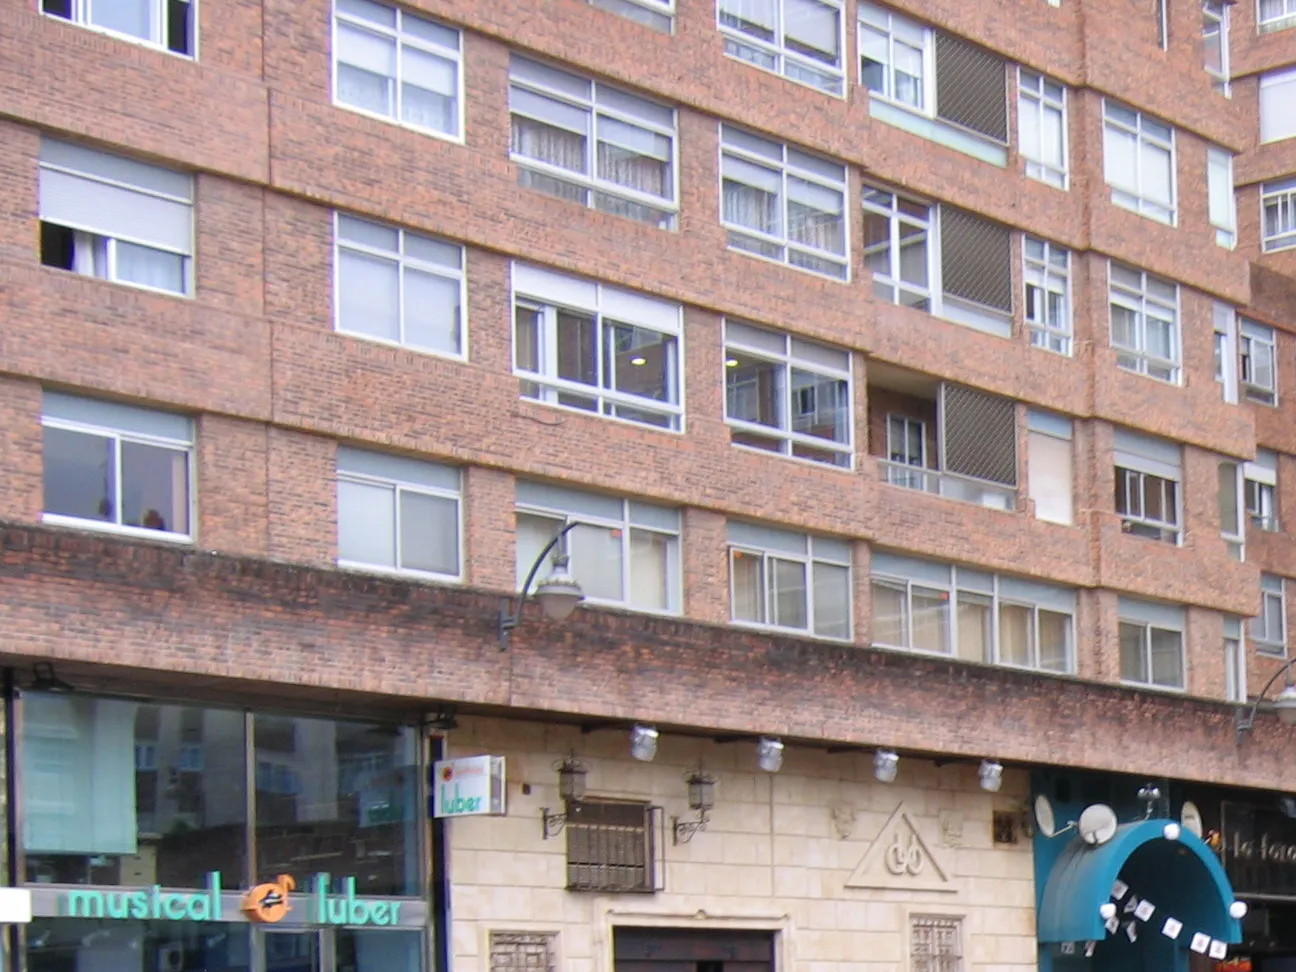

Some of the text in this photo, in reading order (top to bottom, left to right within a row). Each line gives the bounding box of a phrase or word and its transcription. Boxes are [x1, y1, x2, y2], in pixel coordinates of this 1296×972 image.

[441, 783, 483, 814] luber
[68, 871, 402, 926] musical luber
